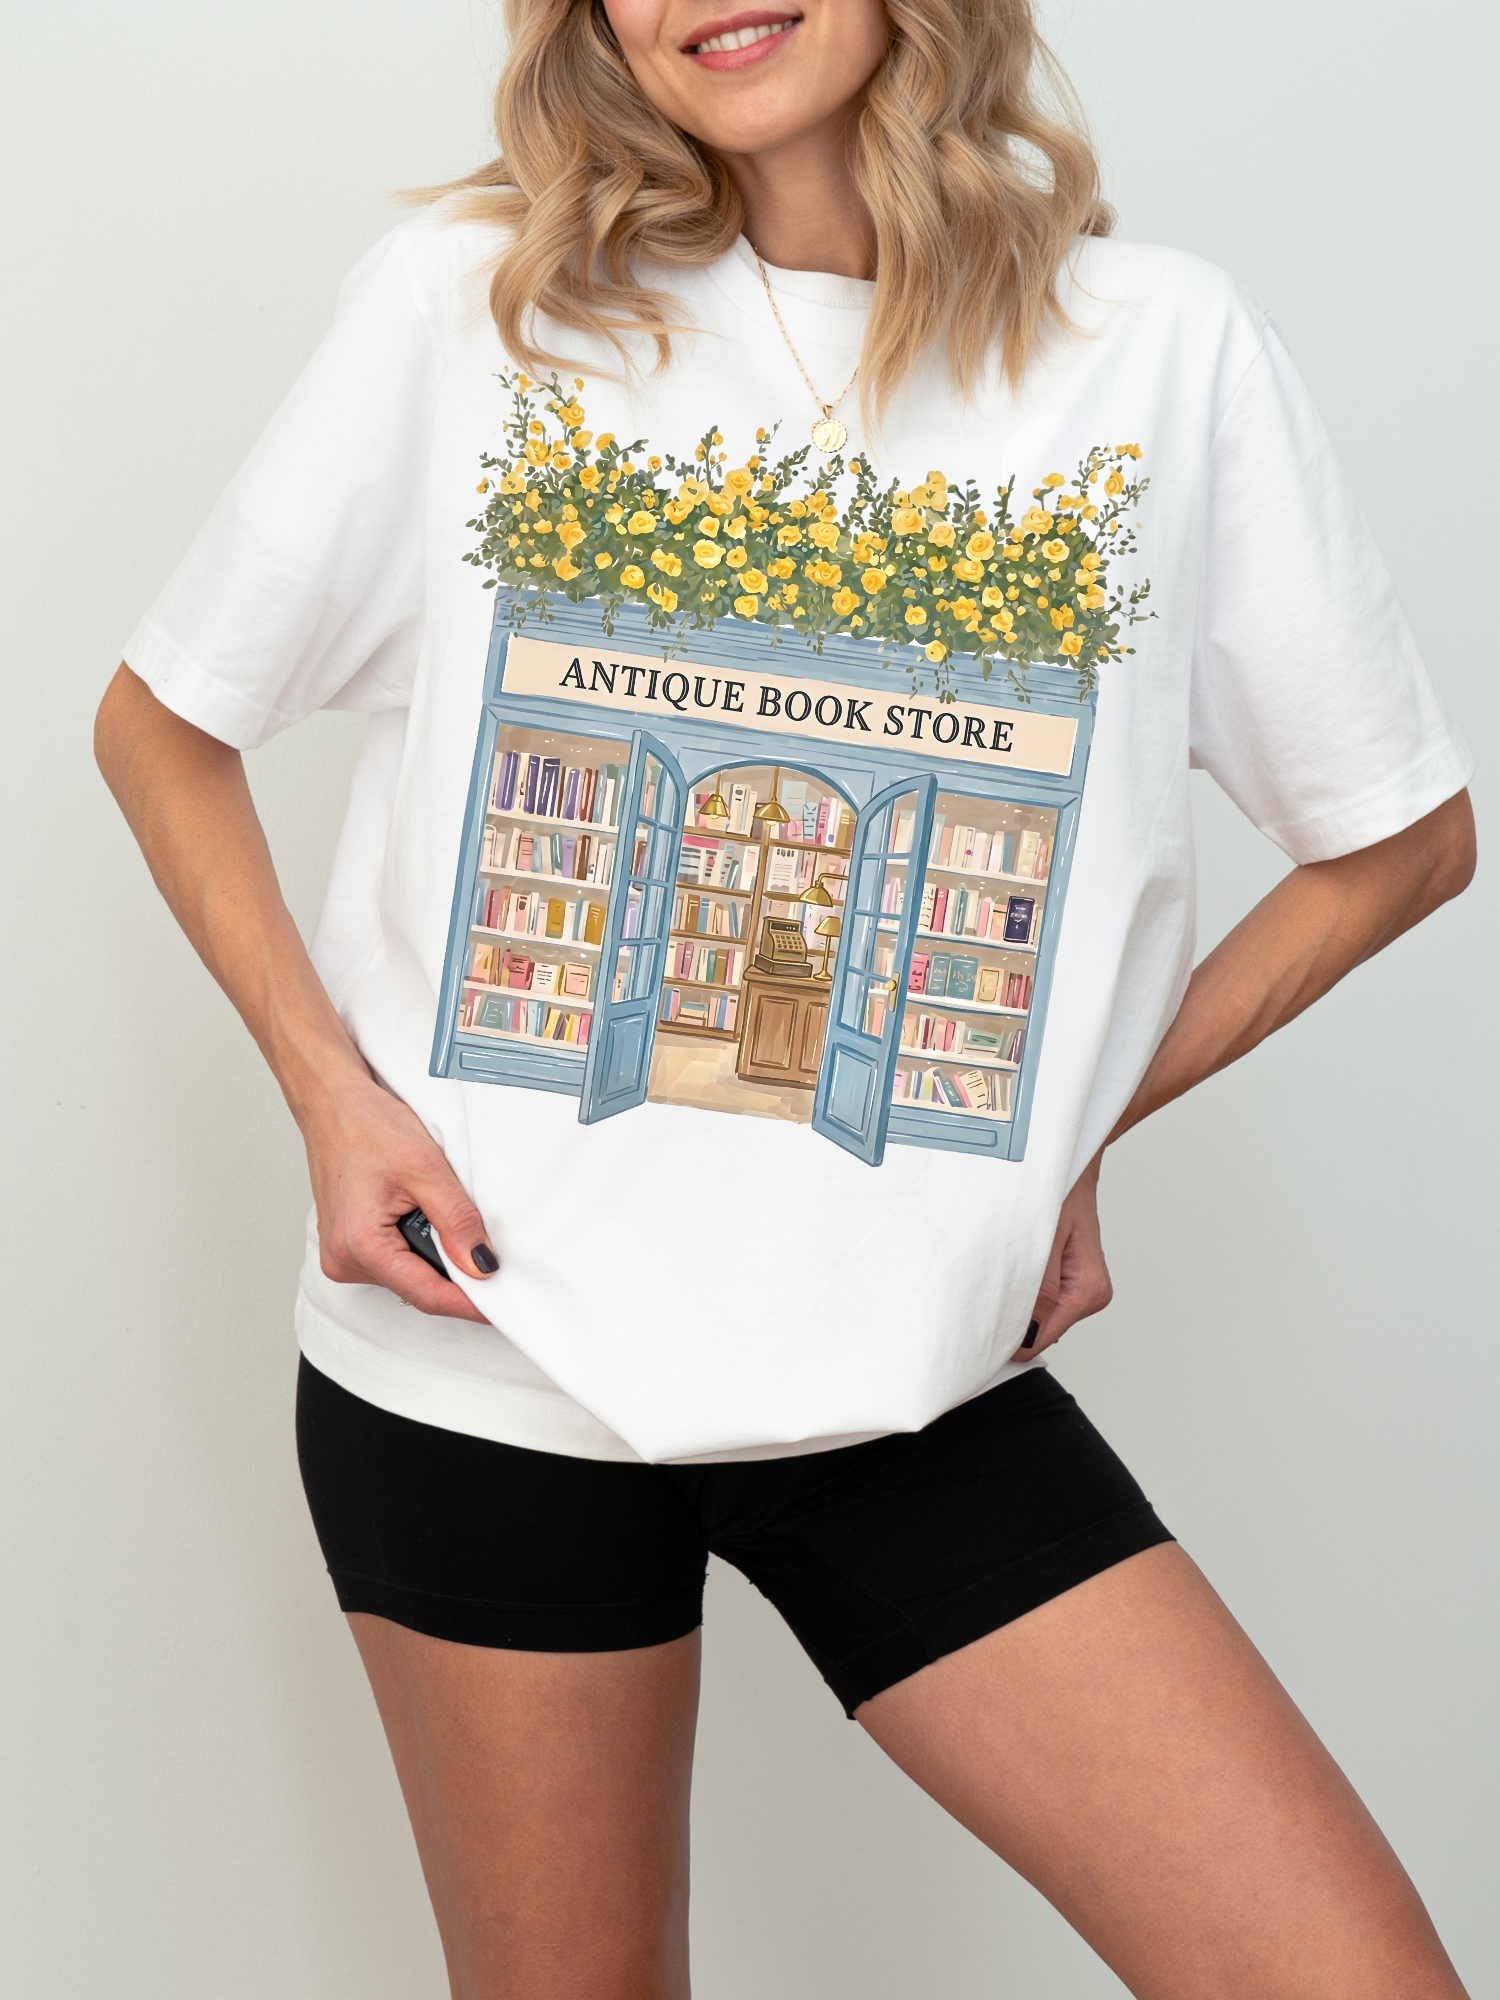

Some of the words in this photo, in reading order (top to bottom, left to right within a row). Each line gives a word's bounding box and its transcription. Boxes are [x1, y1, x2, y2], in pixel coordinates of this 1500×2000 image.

[558, 657, 746, 713] ANTIQUE
[756, 685, 874, 732] BOOK
[883, 705, 1015, 753] STORE
